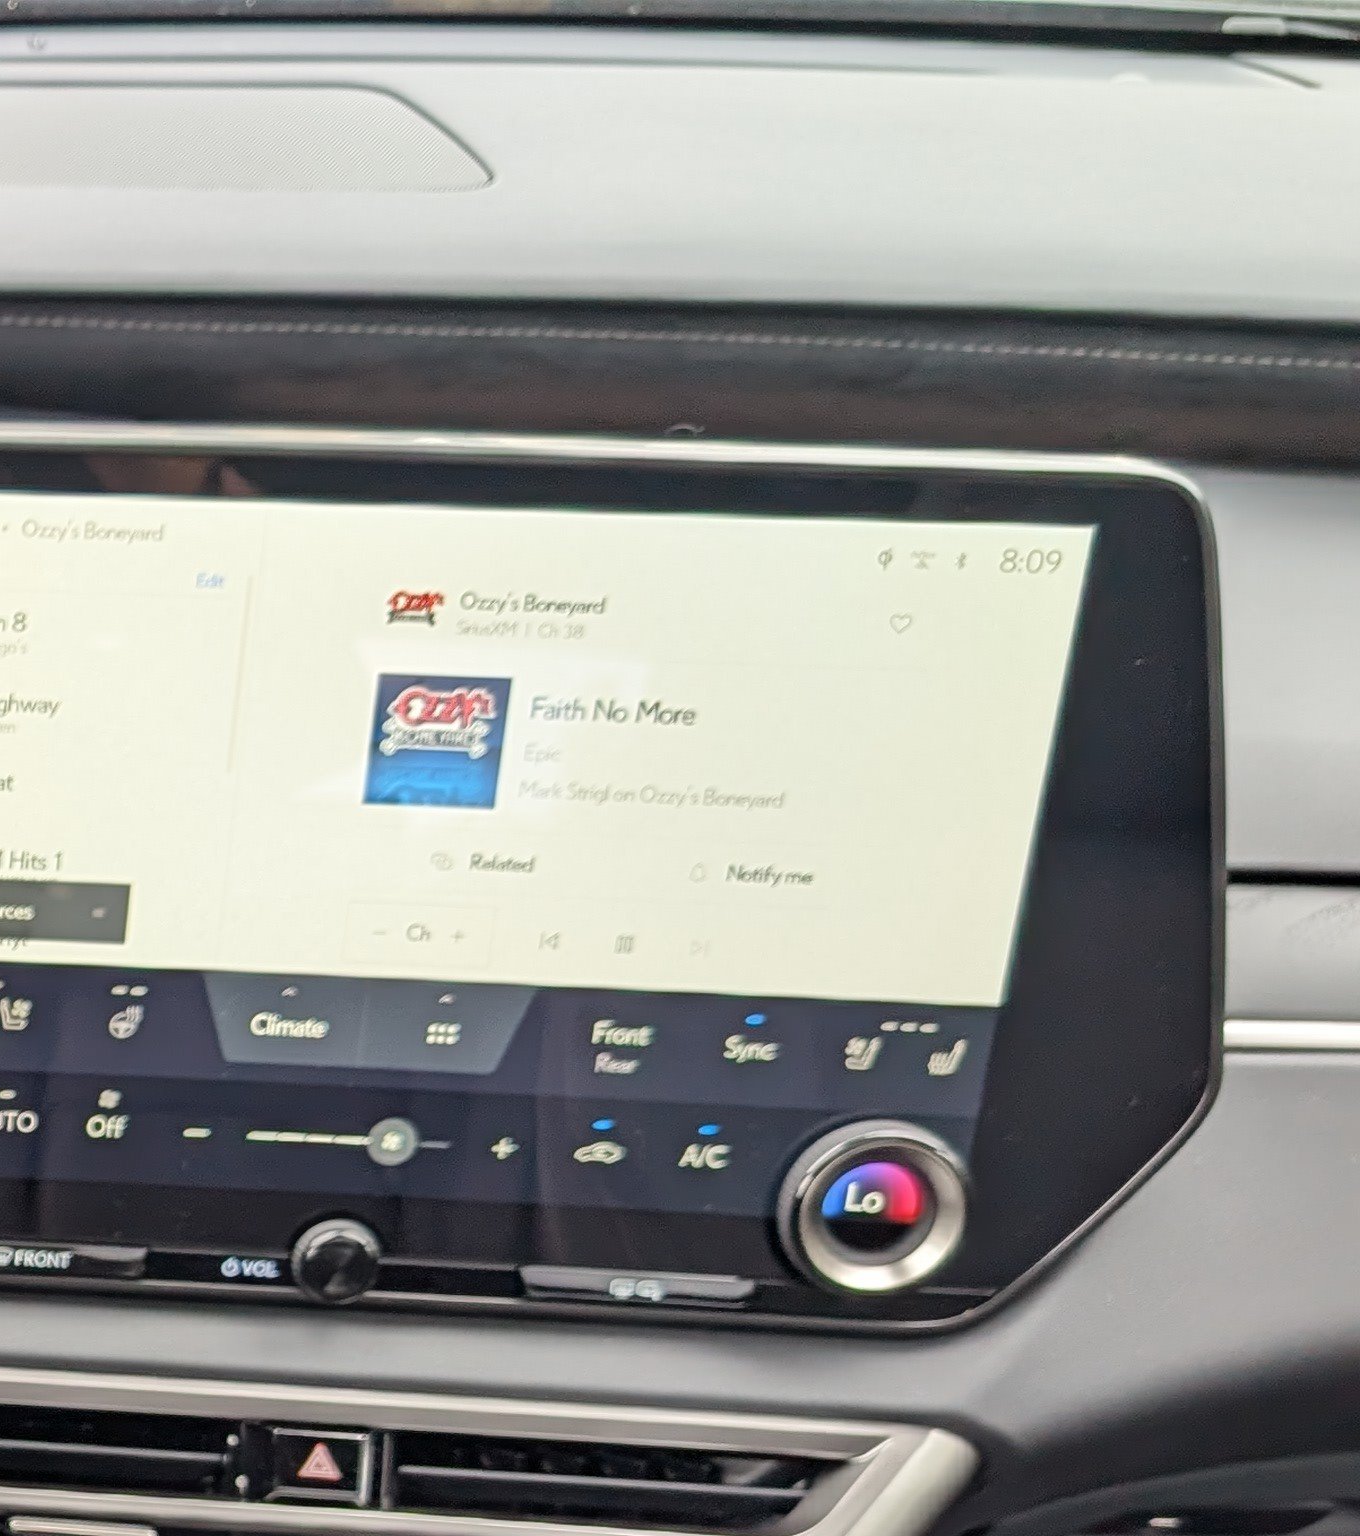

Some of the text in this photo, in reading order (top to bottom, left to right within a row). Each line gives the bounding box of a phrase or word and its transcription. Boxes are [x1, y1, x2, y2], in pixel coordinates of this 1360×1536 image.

[21, 518, 166, 545] Ozzy's Boneyard
[1000, 548, 1063, 574] 8:09
[195, 572, 225, 589] Edit
[459, 591, 607, 616] Ozzy's Boneyard
[11, 611, 28, 634] 8
[529, 695, 699, 727] Faith No More
[523, 741, 562, 765] Epic
[638, 783, 700, 808] Ozzy's
[702, 786, 787, 810] Boneyard
[8, 848, 48, 872] Hits
[53, 850, 65, 872] 1
[469, 851, 537, 874] Related
[725, 863, 815, 888] Notify me
[406, 922, 431, 943] Ch
[249, 1011, 331, 1040] Climate
[591, 1018, 657, 1048] Front
[722, 1034, 783, 1064] Sync
[85, 1113, 132, 1141] Off
[677, 1143, 733, 1170] A/C
[844, 1181, 885, 1214] Lo
[13, 1249, 74, 1271] FRONT
[241, 1257, 280, 1279] VOL
